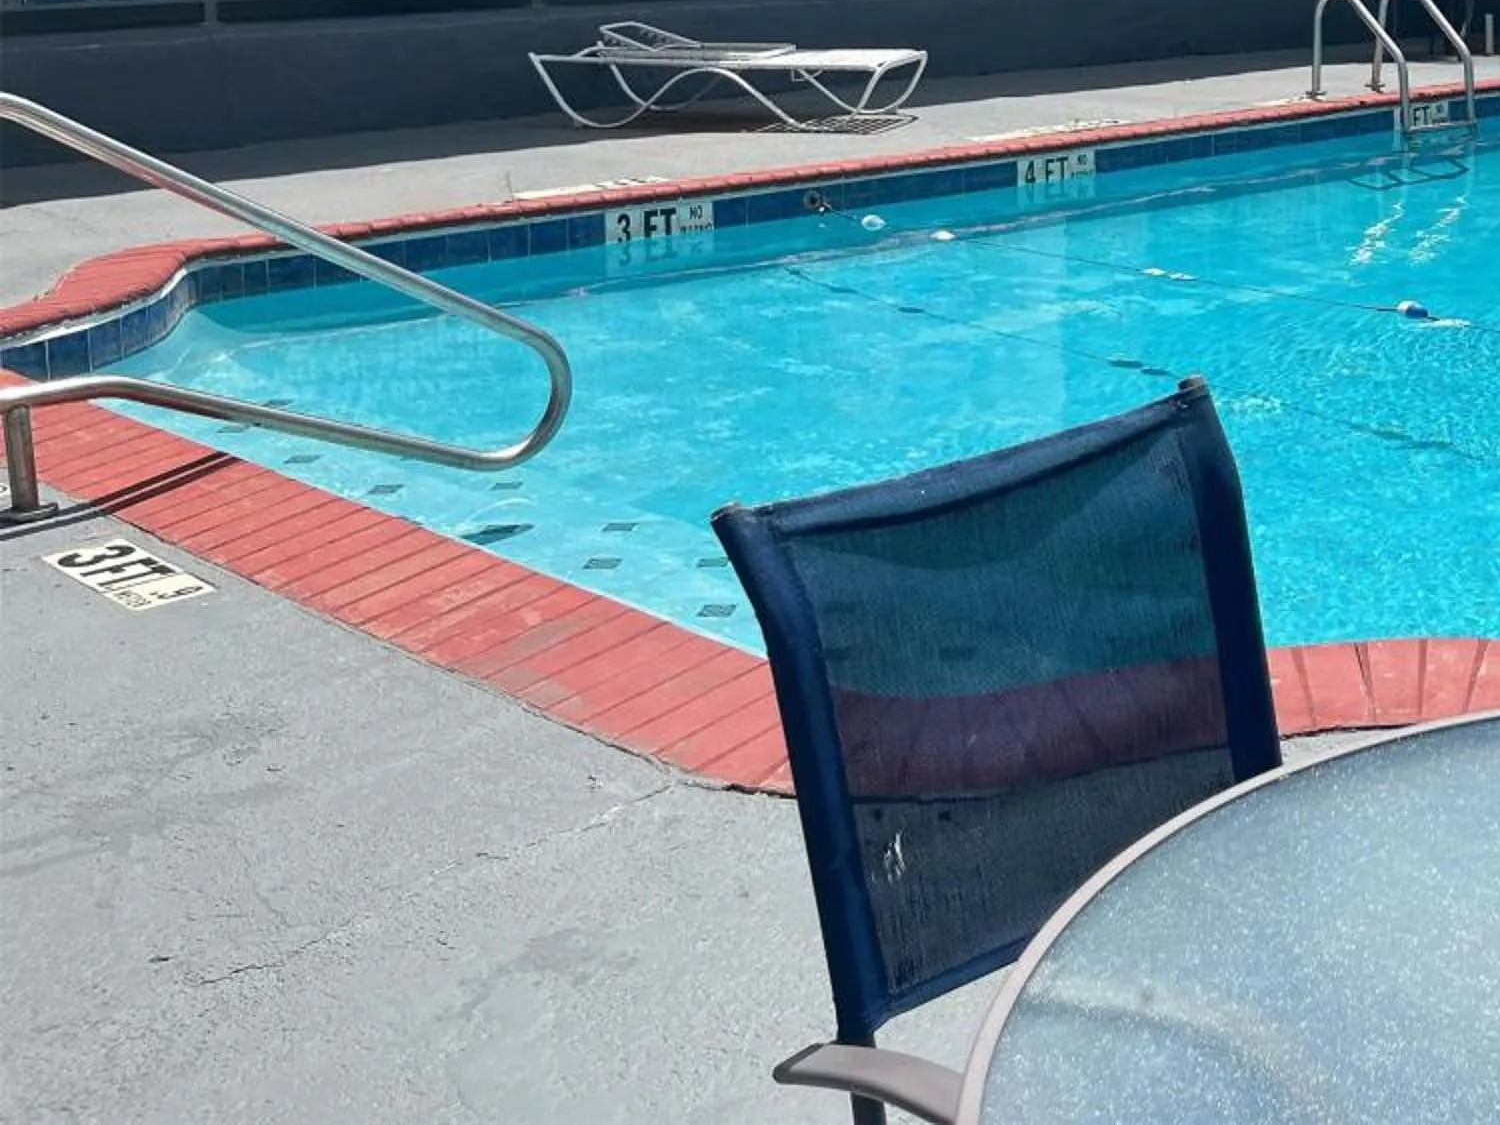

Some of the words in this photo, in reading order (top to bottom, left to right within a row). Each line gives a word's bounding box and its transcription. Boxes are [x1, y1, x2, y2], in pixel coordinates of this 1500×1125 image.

[1025, 160, 1036, 183] 4
[1045, 157, 1068, 183] FT
[617, 213, 631, 243] 3
[643, 207, 677, 238] FT
[689, 205, 703, 219] NO
